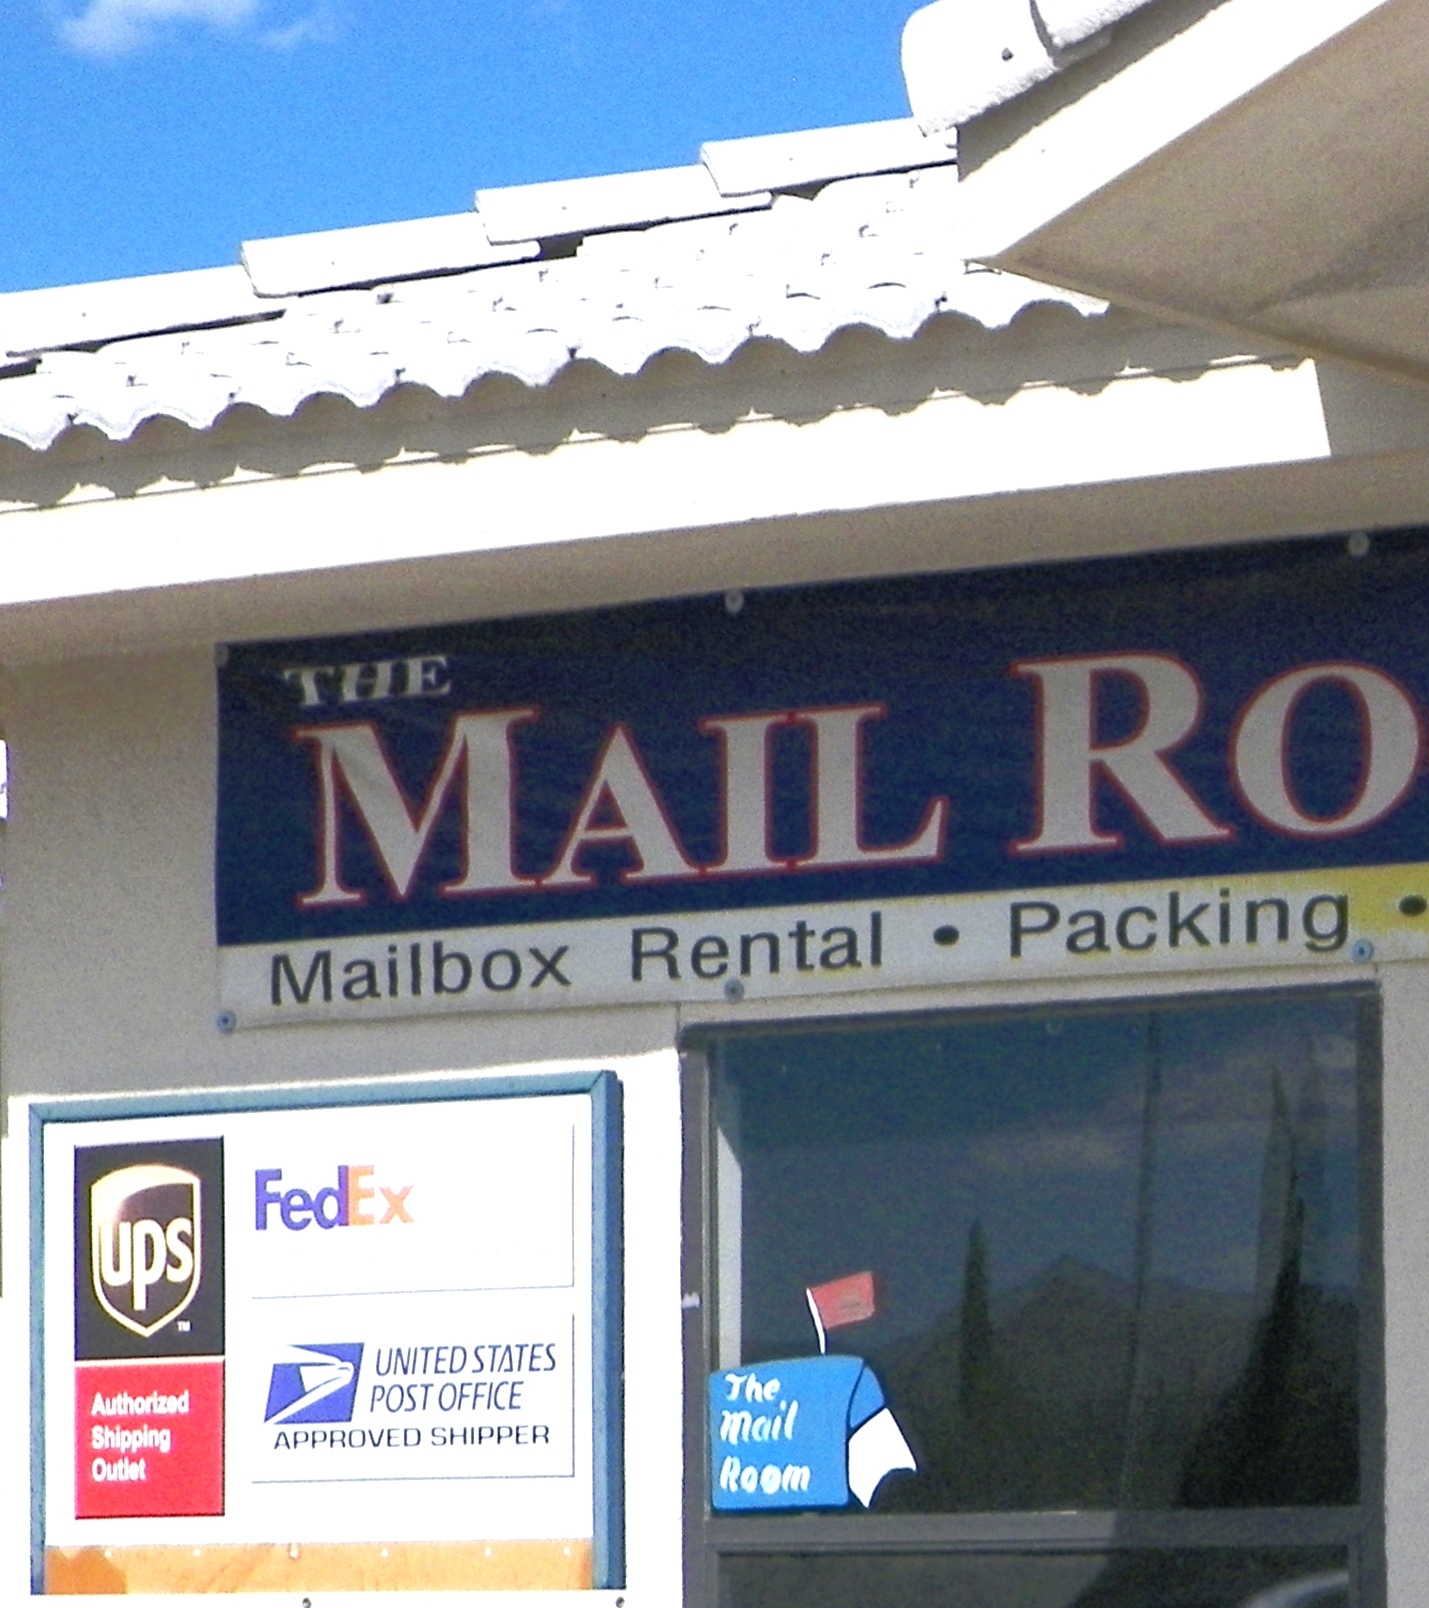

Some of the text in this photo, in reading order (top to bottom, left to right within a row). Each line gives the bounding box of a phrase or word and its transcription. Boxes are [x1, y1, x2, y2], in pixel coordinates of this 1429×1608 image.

[283, 655, 450, 706] THE
[291, 704, 948, 909] MAIL
[271, 942, 571, 1006] Mailbox
[631, 911, 883, 982] Rental
[1010, 886, 1349, 957] Packing
[254, 1164, 415, 1231] FedEx
[100, 1217, 194, 1310] ups
[374, 1342, 557, 1378] UNITED STATES
[91, 1390, 190, 1417] Authorized
[369, 1380, 524, 1413] POST OFFICE
[725, 1373, 781, 1402] The
[91, 1424, 171, 1452] Shipping
[274, 1424, 550, 1451] APPROVED SHIPPER
[720, 1400, 798, 1445] Mail
[91, 1457, 146, 1482] Outlet
[720, 1456, 810, 1494] Room
